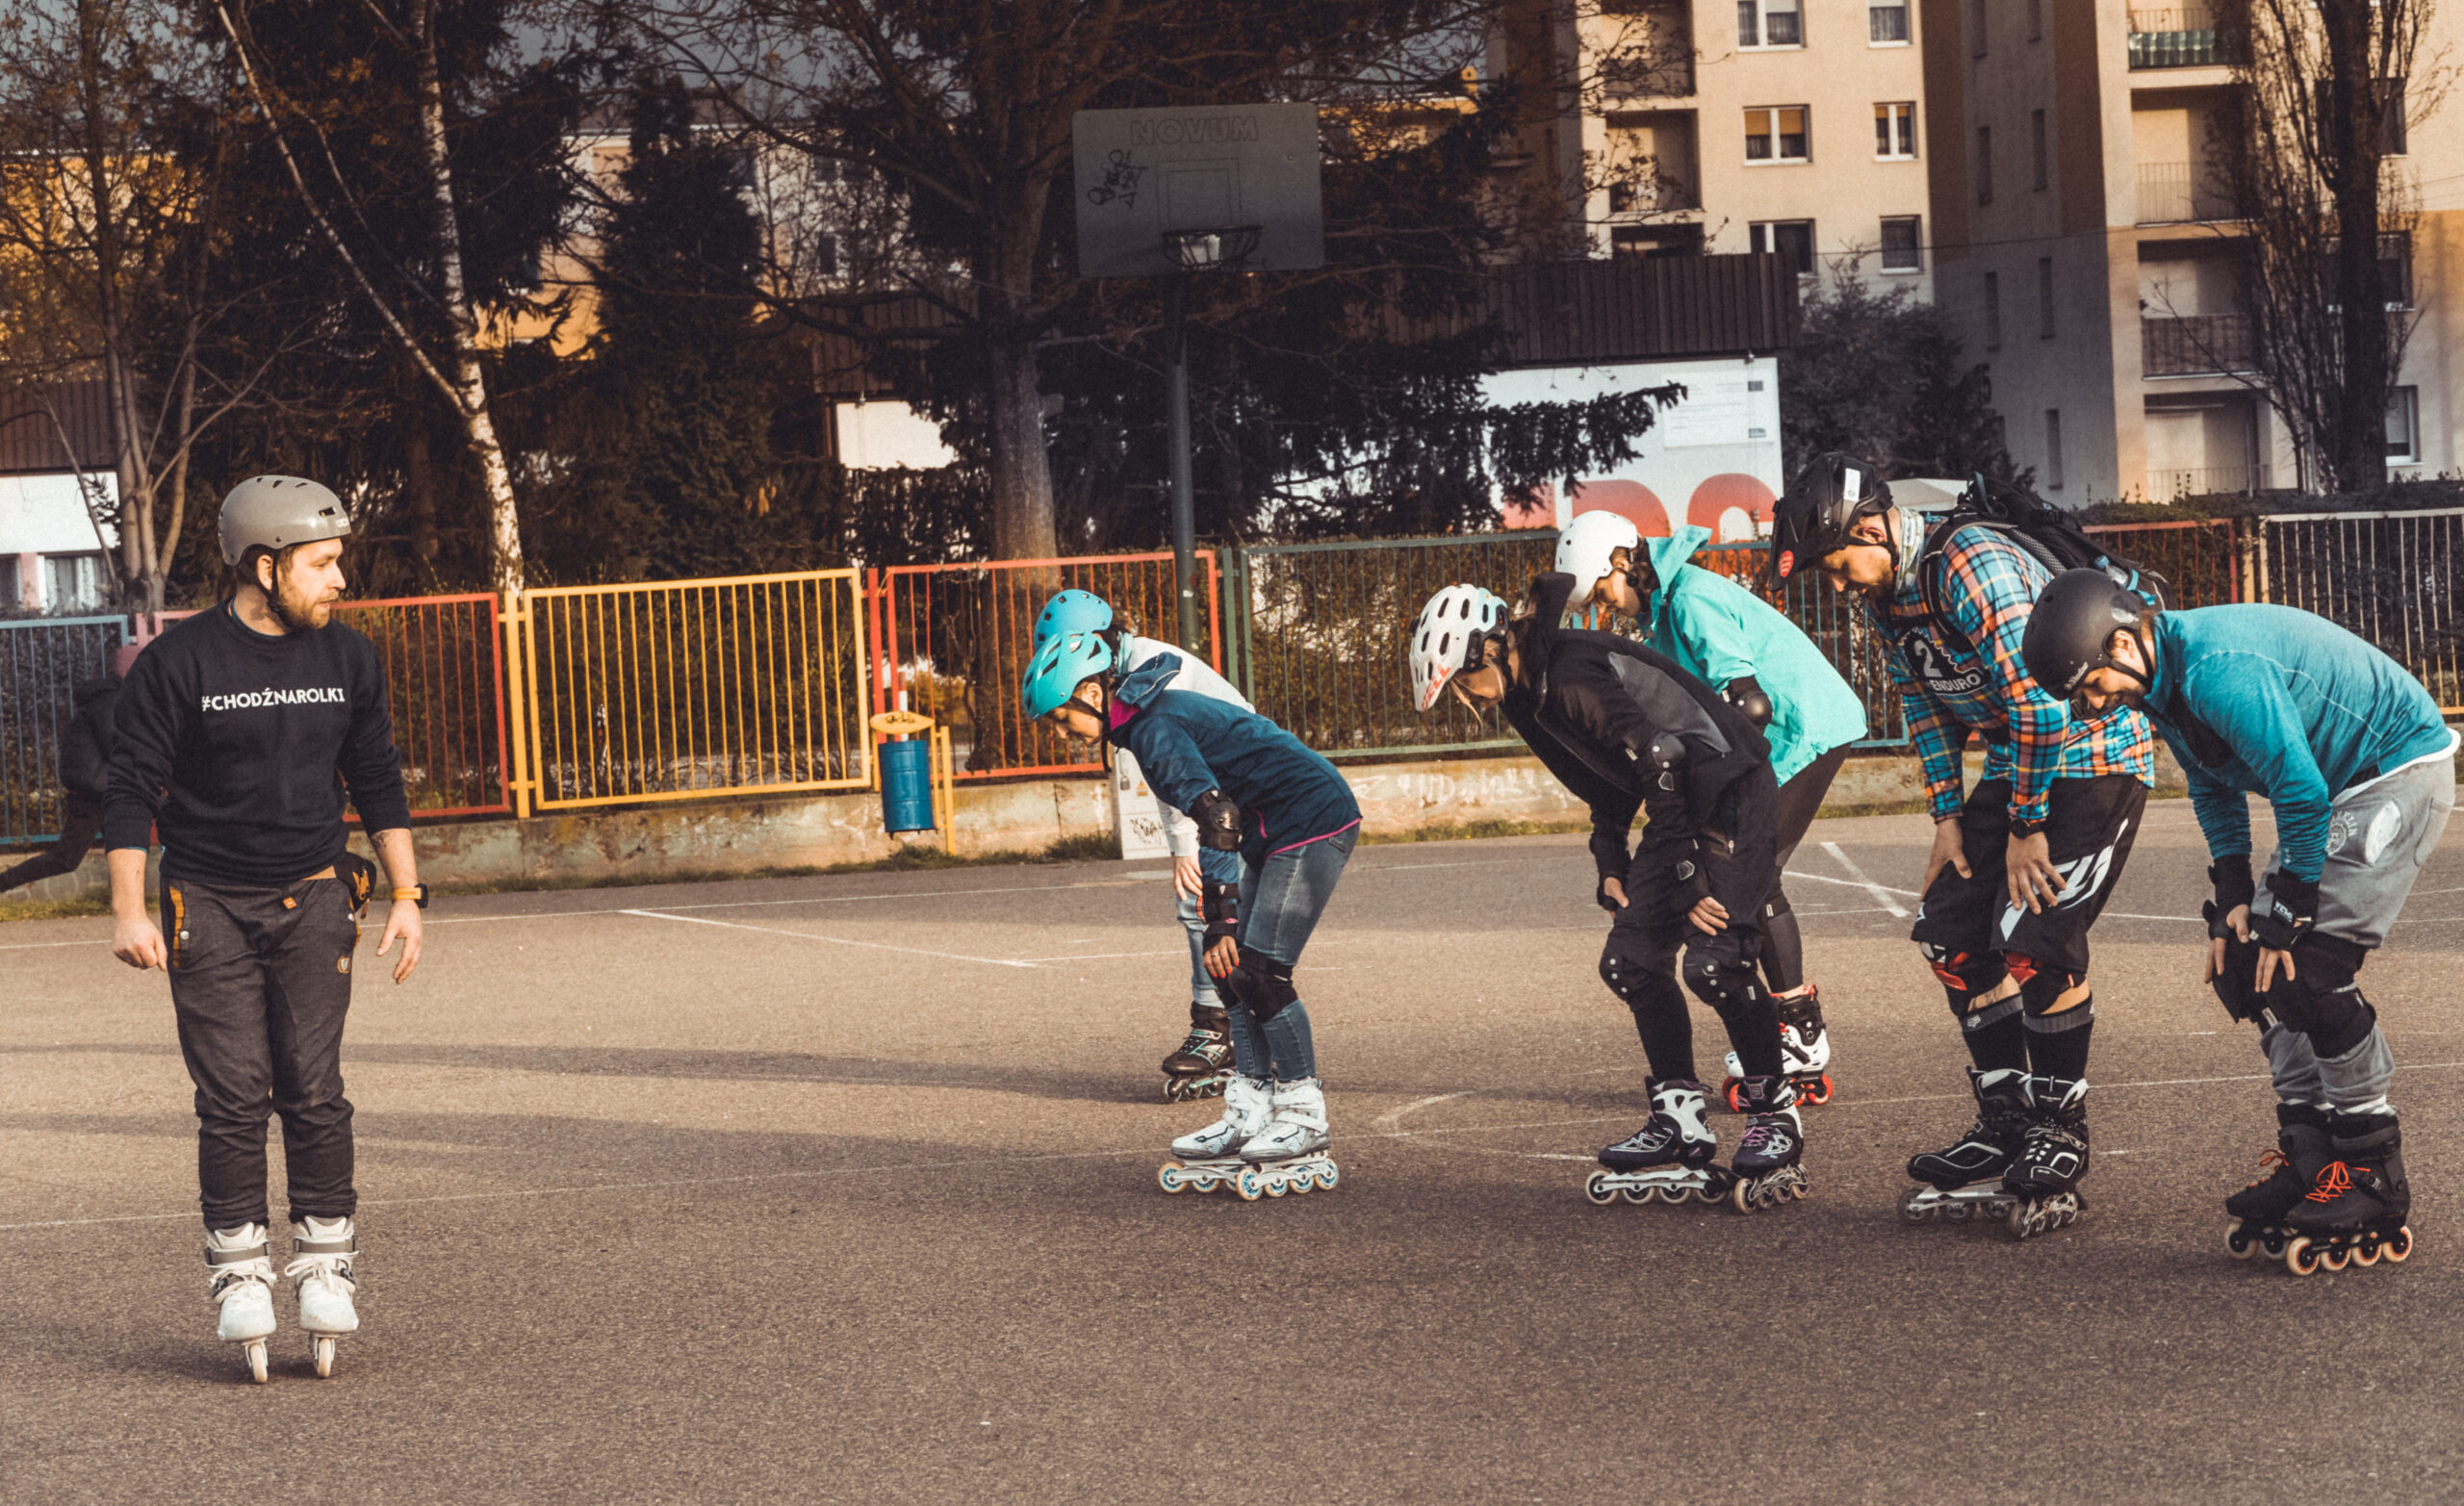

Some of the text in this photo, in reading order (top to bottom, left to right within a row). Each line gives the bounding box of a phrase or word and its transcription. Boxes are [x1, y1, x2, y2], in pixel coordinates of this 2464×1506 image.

[1130, 115, 1259, 146] NOVUM
[1914, 640, 1942, 677] 2
[1421, 663, 1450, 710] BELL
[1929, 674, 1981, 692] ENDURO
[201, 687, 346, 711] #CHODŹNAROLKI
